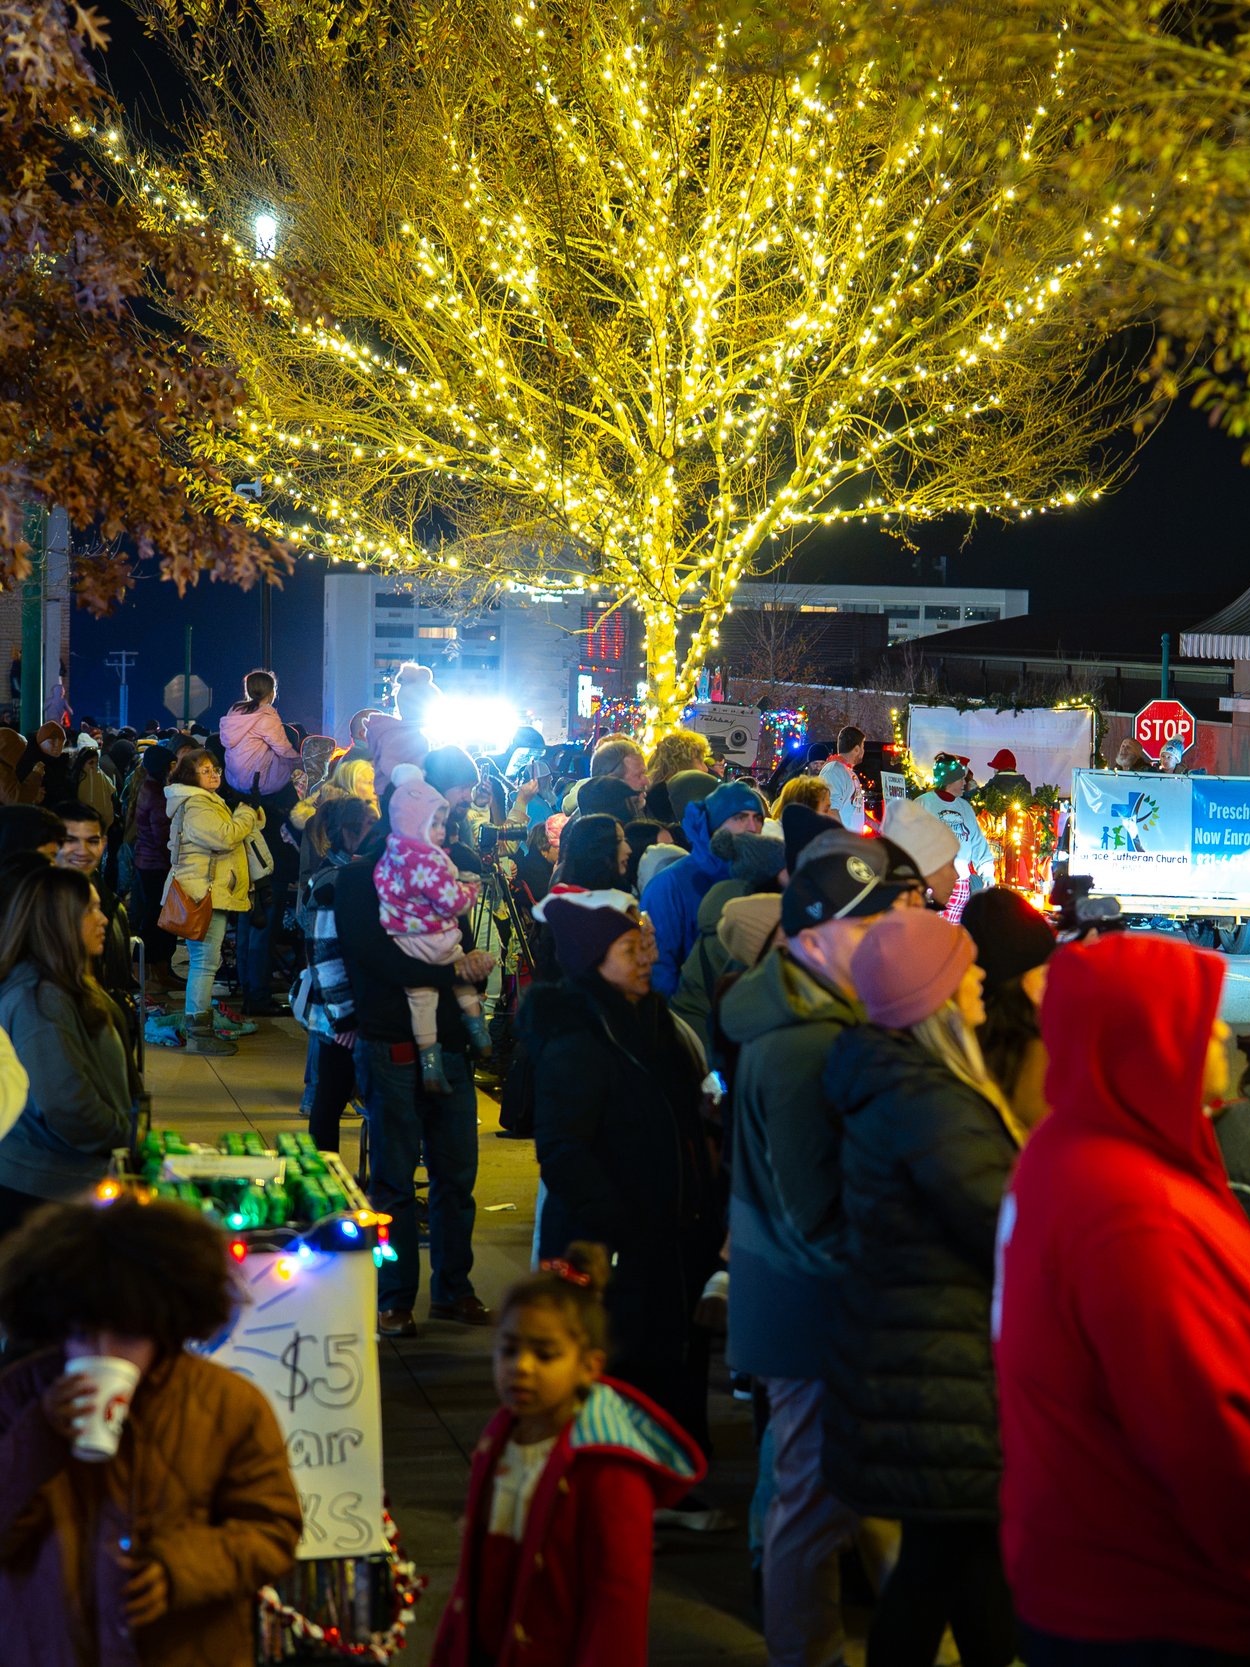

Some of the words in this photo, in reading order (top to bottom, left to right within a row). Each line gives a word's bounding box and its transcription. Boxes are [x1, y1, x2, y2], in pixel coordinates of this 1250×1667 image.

[1139, 719, 1190, 740] STOP
[1194, 828, 1220, 845] Now
[1156, 854, 1188, 864] Church
[275, 1330, 364, 1411] $5
[286, 1428, 364, 1470] ar
